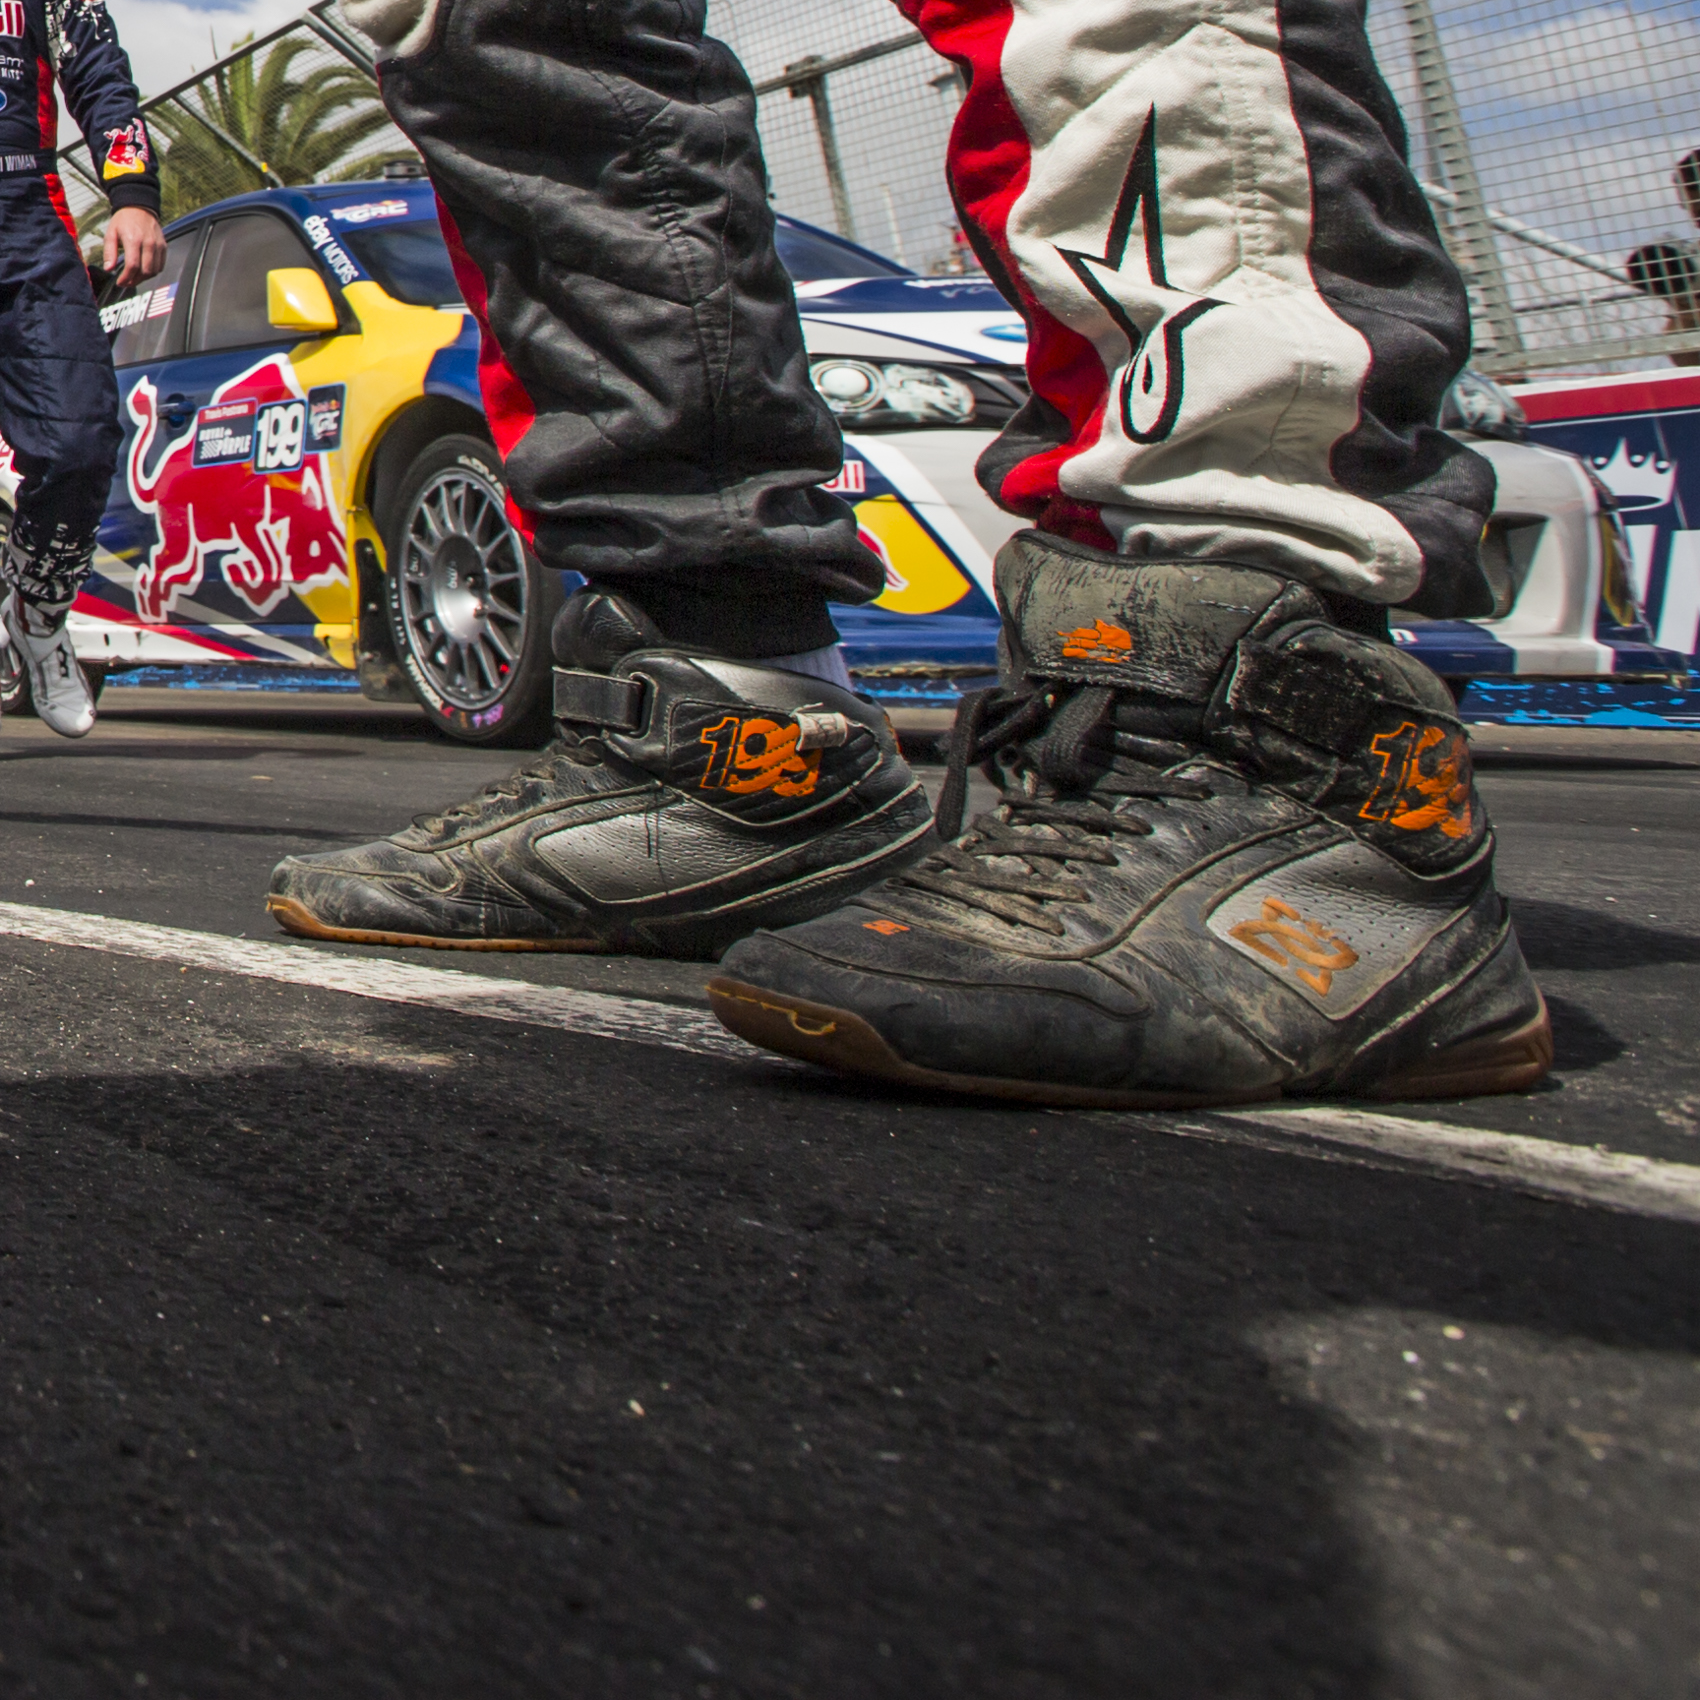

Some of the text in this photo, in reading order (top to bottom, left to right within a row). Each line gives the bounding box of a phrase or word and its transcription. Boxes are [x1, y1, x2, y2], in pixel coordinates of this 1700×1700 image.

[5, 154, 38, 172] WIMAN
[303, 214, 335, 251] ebay
[322, 241, 360, 285] MOTORS
[257, 402, 306, 469] 199
